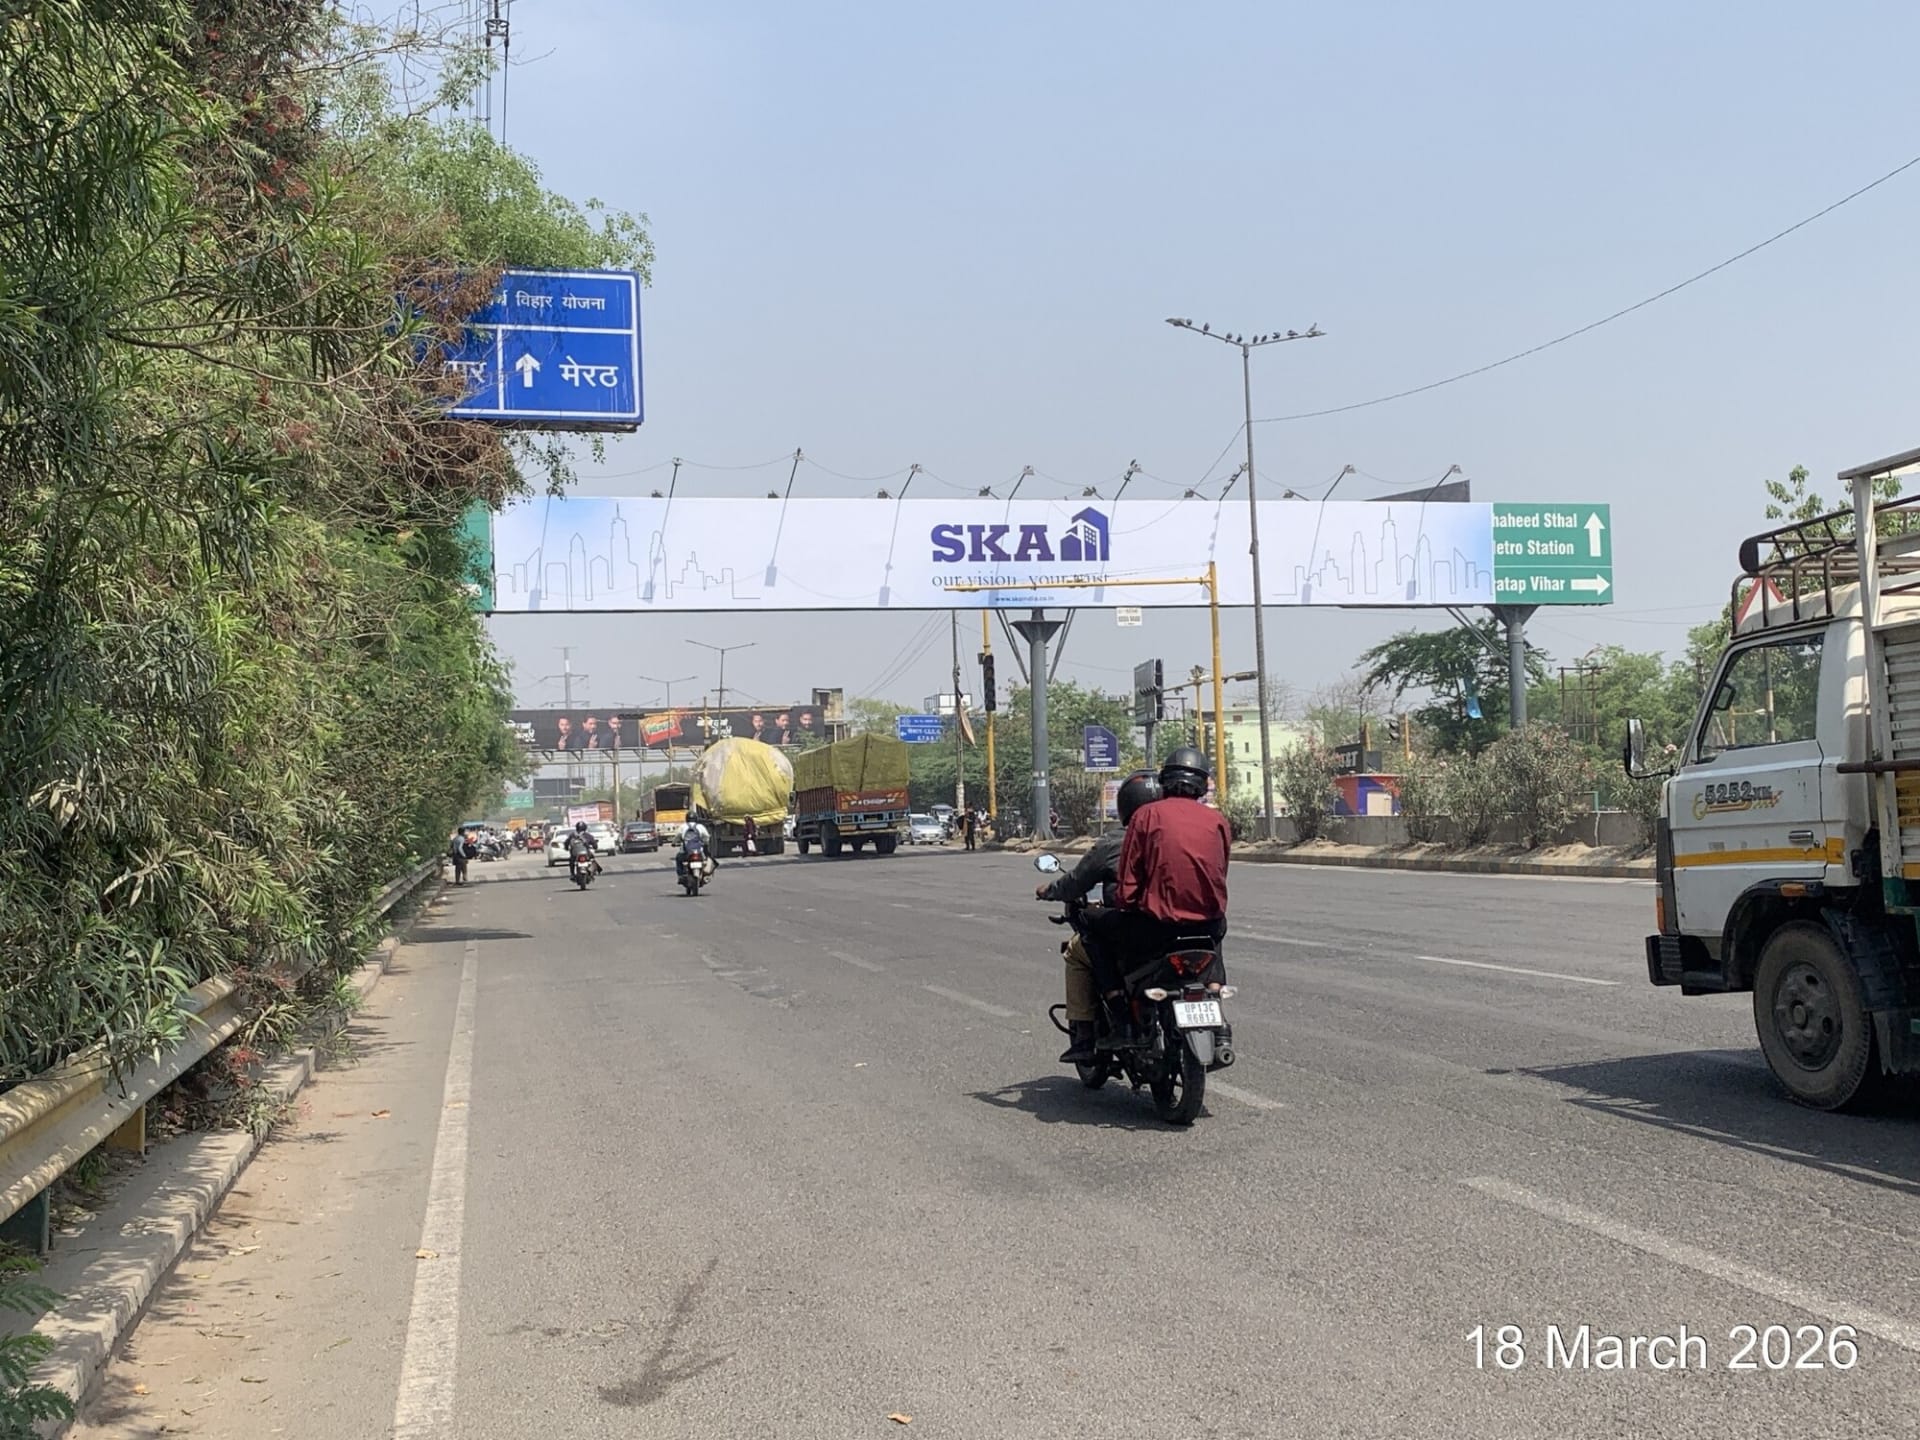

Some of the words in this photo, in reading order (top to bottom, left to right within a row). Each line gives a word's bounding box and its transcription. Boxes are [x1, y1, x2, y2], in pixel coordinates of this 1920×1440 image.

[515, 289, 553, 309] विहार
[562, 292, 606, 310] योजना
[558, 355, 619, 388] मेरठ
[1492, 513, 1539, 528] haheed
[1544, 513, 1577, 528] Sthal
[931, 523, 1055, 563] SKA
[1493, 540, 1523, 555] etro
[1528, 540, 1574, 555] Station
[1494, 577, 1526, 593] atap
[1530, 576, 1564, 591] Vihar
